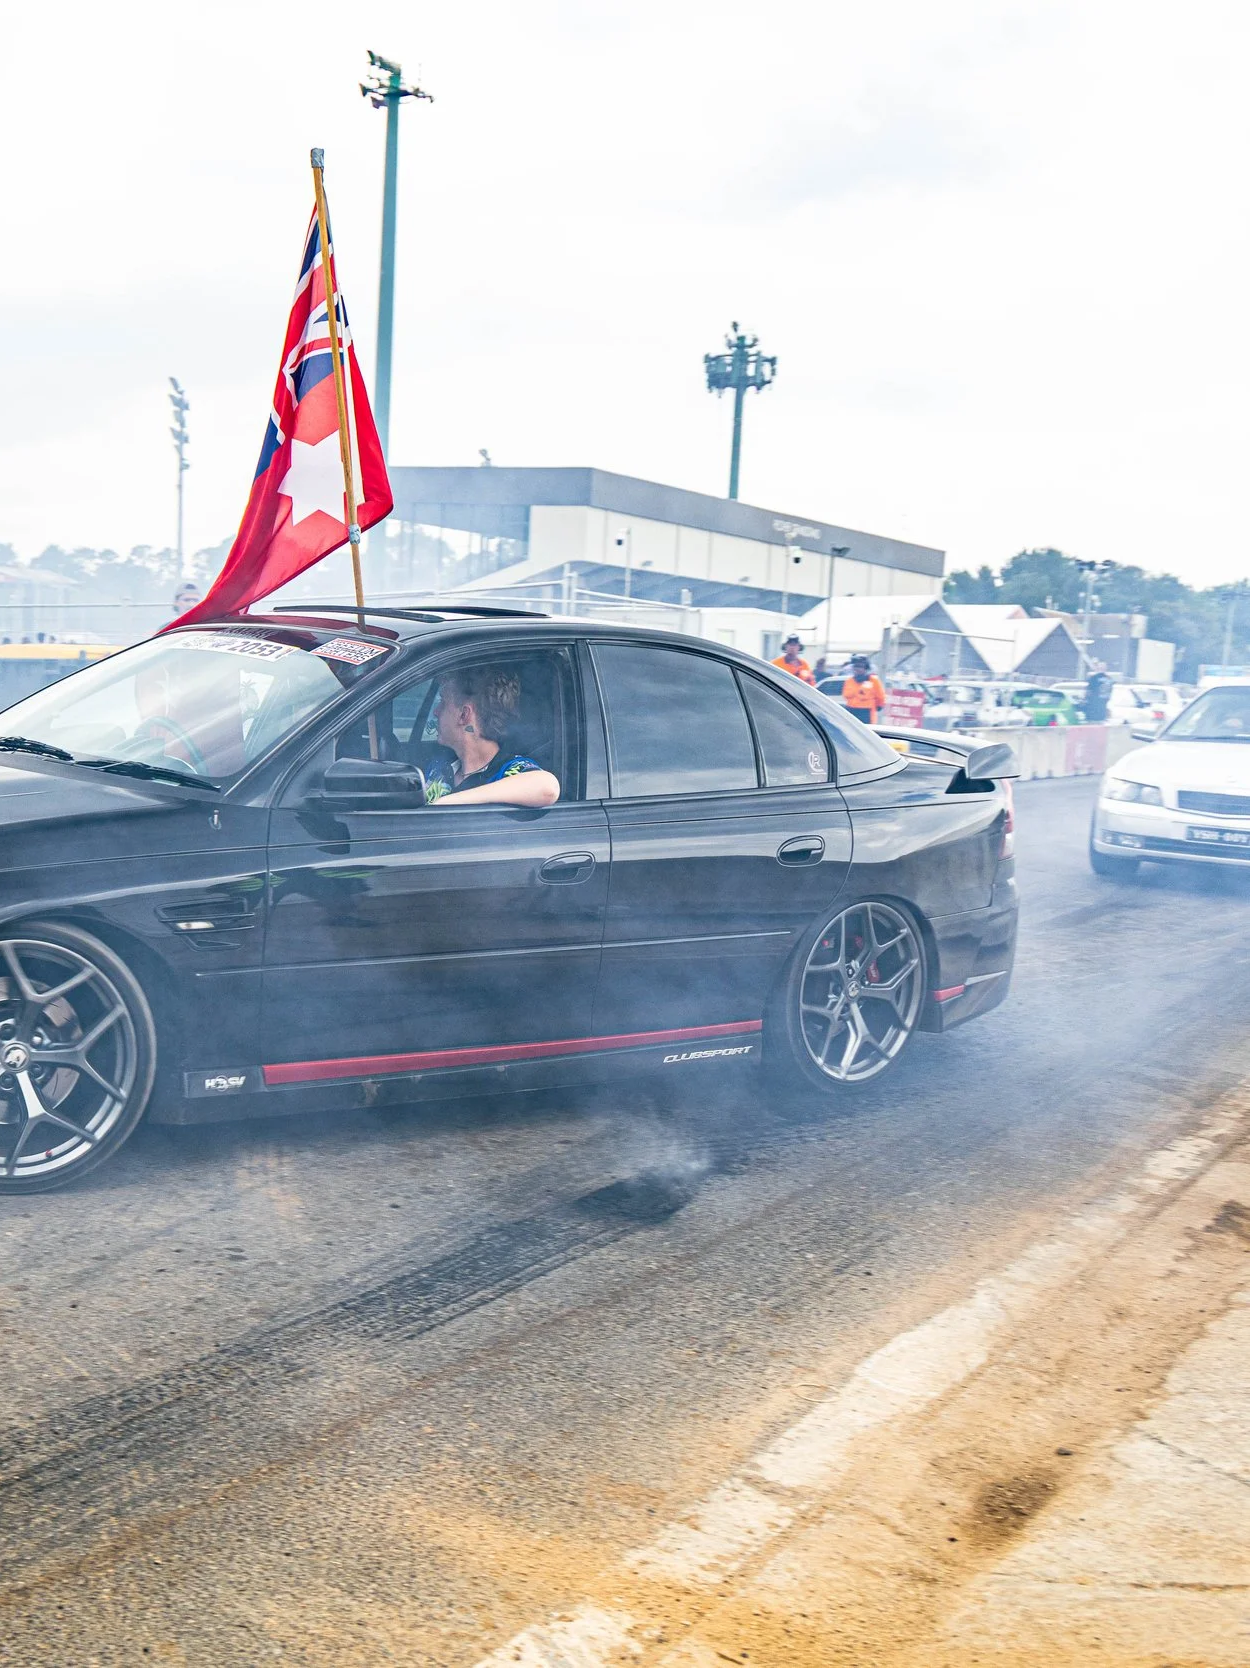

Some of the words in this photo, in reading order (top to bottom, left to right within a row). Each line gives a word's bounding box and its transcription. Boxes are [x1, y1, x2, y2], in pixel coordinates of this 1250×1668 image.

[229, 641, 282, 657] 2053
[662, 1045, 754, 1063] CLUBSPORT
[204, 1075, 247, 1091] HSV
